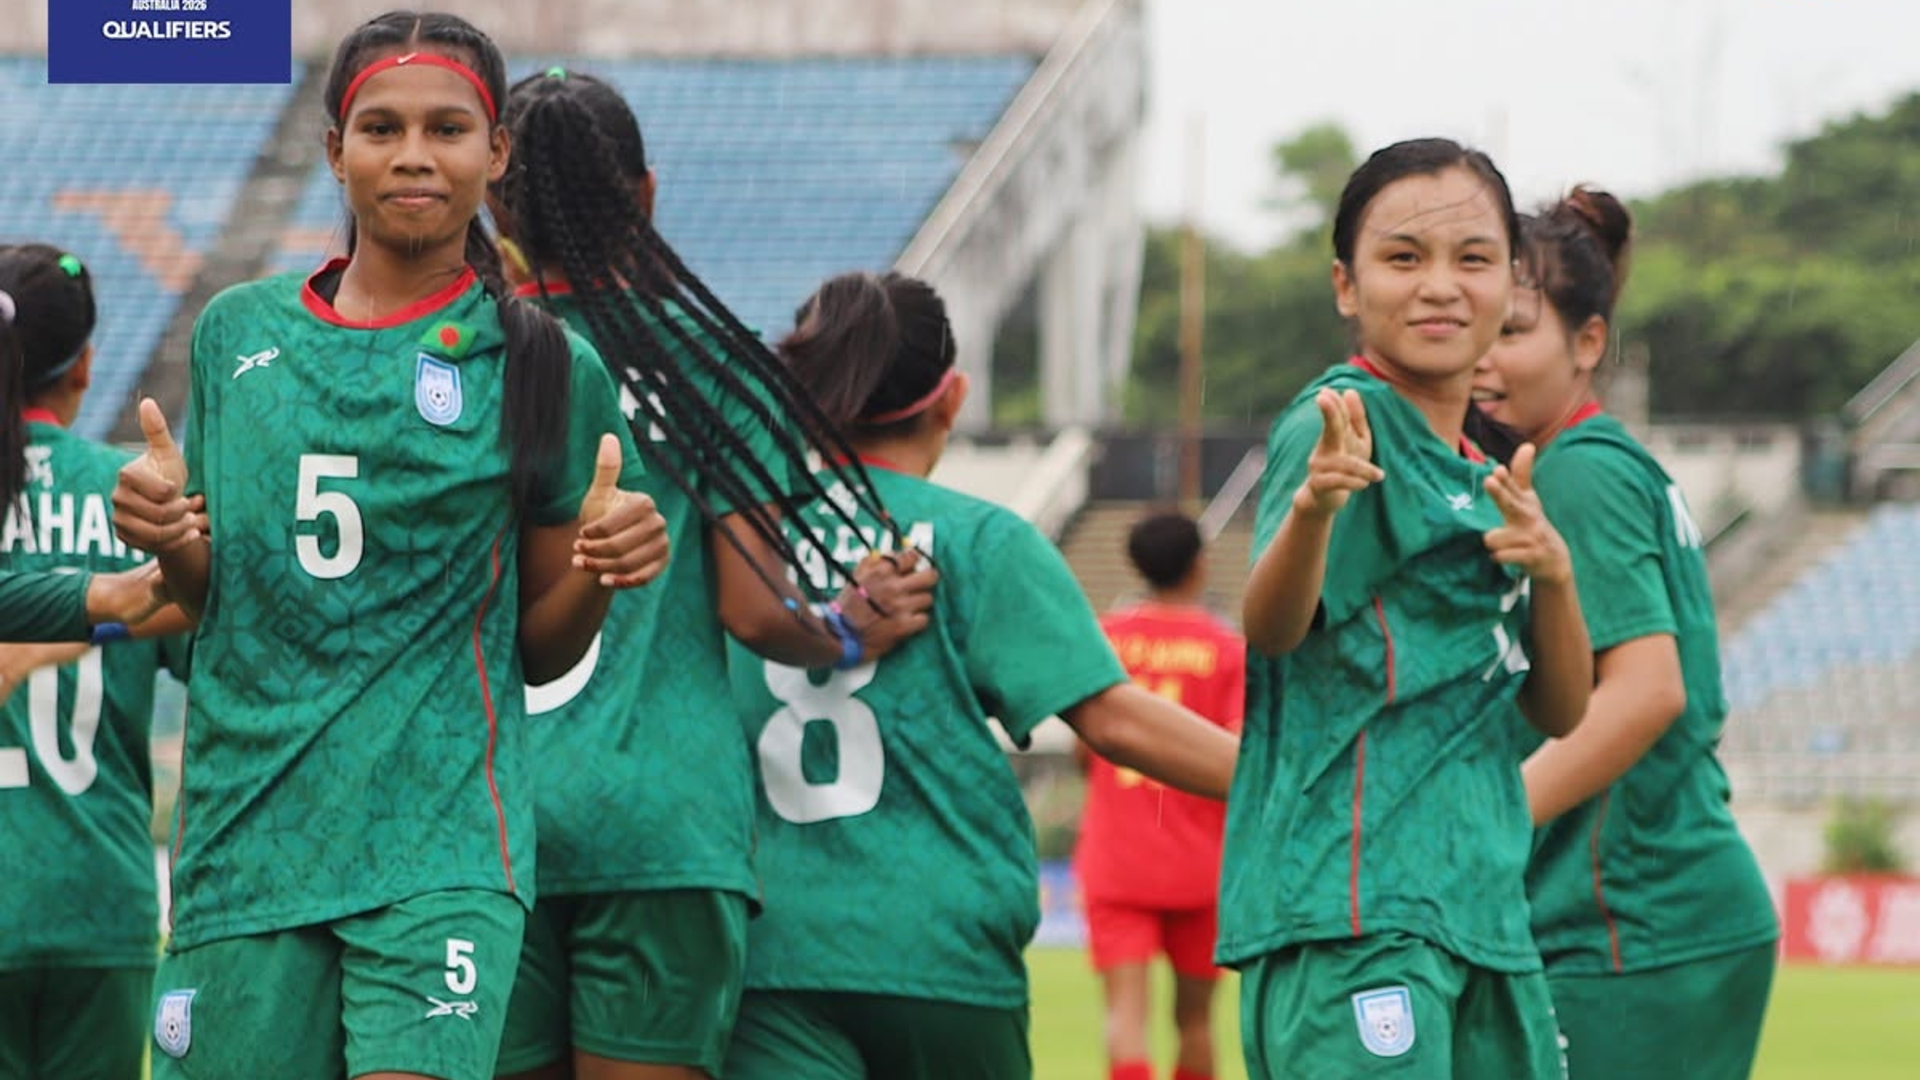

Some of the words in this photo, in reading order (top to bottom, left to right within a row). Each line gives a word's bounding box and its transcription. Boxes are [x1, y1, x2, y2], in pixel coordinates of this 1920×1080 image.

[295, 454, 364, 580] 5
[757, 655, 885, 824] 8
[444, 938, 478, 995] 5
